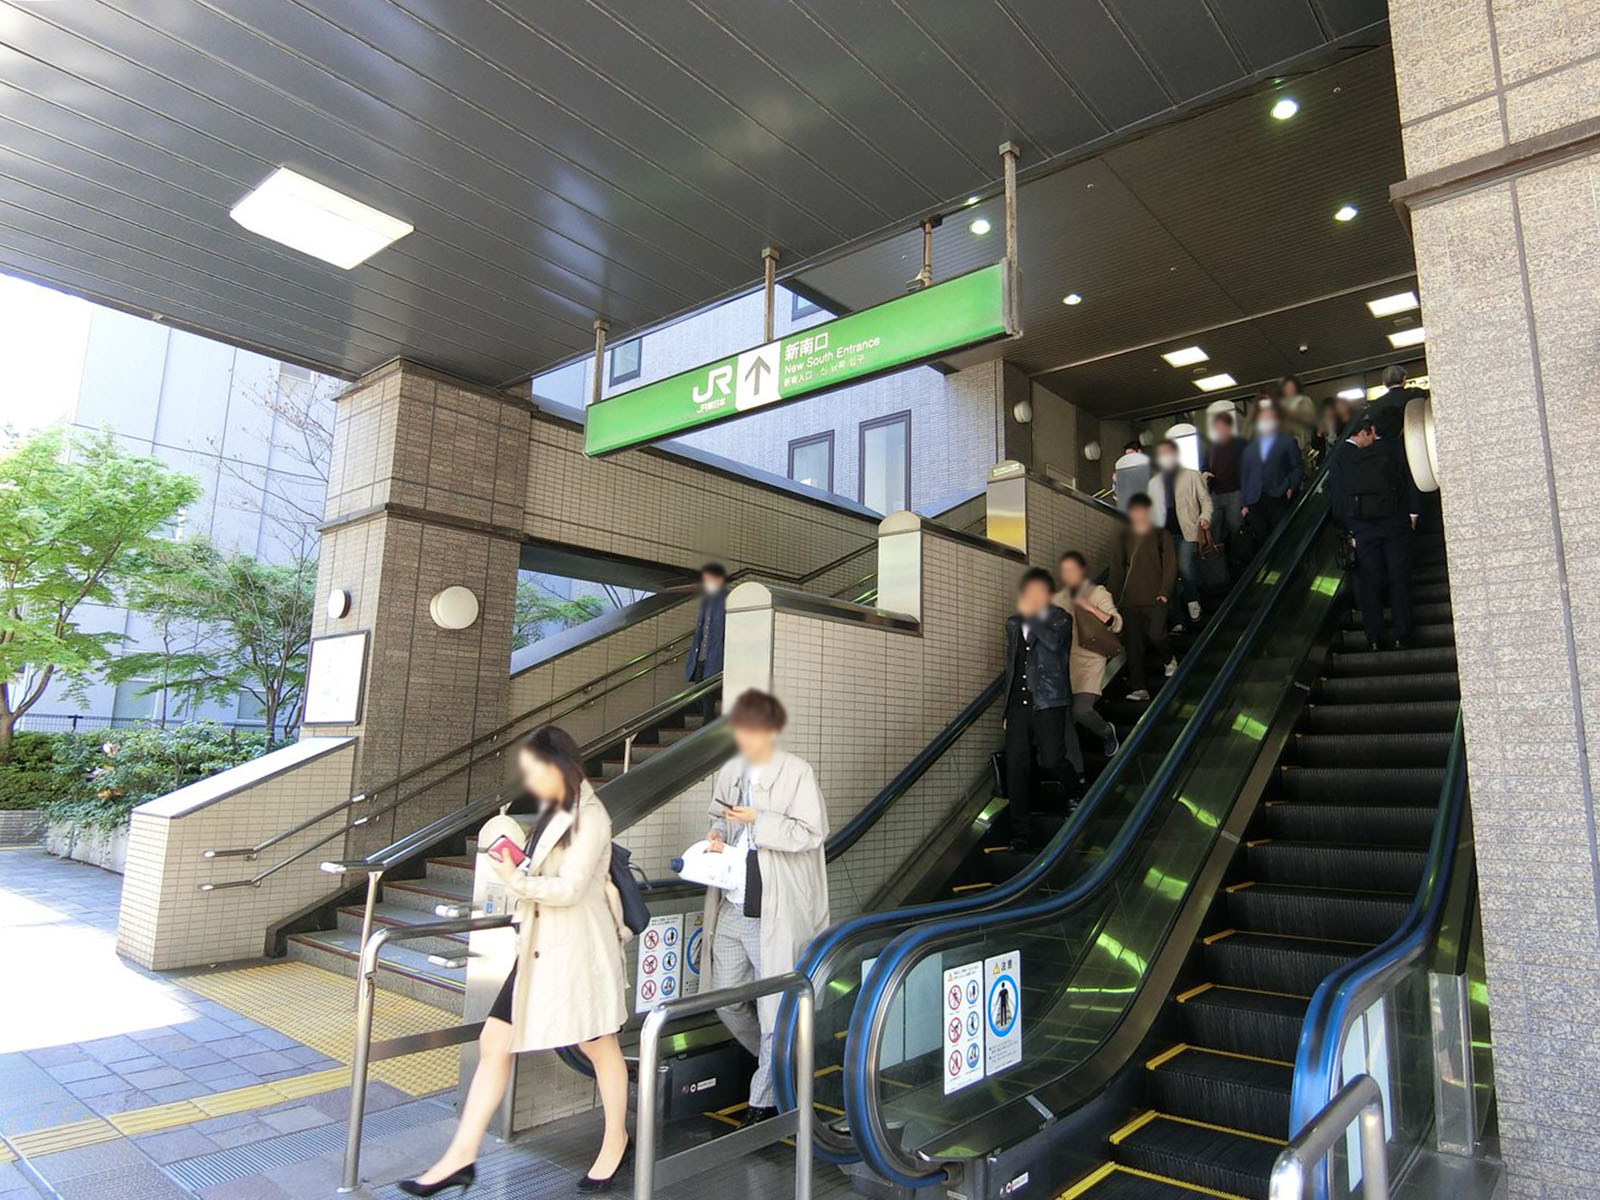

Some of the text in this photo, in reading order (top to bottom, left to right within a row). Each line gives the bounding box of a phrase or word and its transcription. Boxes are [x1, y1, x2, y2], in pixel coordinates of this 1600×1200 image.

[784, 362, 804, 376] New
[806, 351, 833, 368] South
[837, 337, 880, 358] Entrance
[785, 332, 828, 362] 新南口
[692, 364, 733, 403] JR
